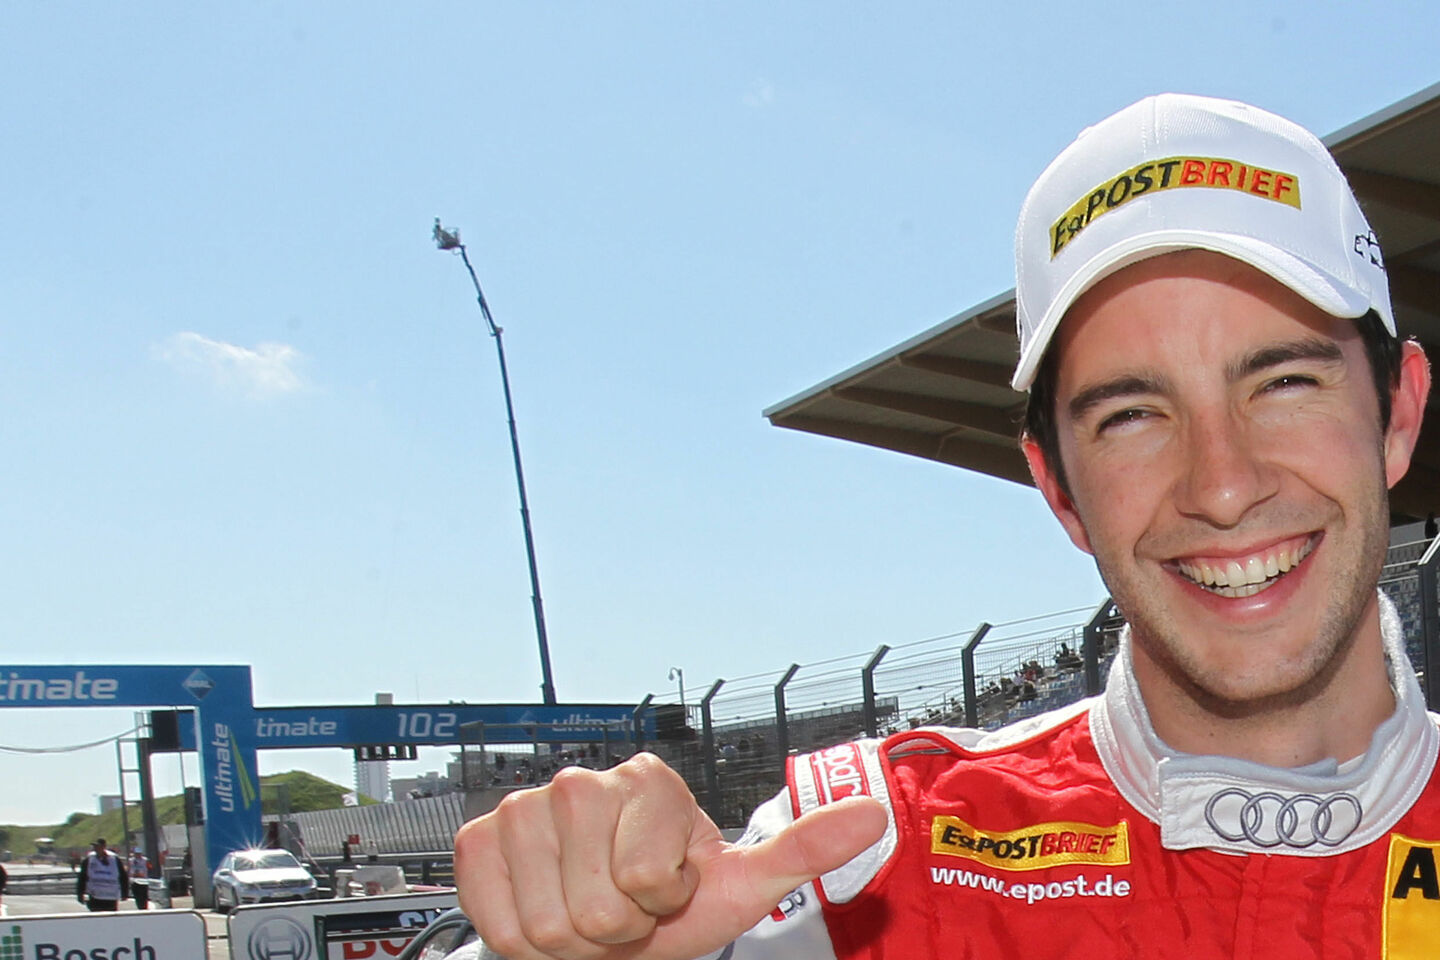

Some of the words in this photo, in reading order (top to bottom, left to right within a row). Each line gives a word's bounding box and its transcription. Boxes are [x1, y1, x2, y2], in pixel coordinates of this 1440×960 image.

[397, 712, 457, 738] 102
[214, 723, 234, 812] ultimate
[930, 866, 1130, 905] www.epost.de
